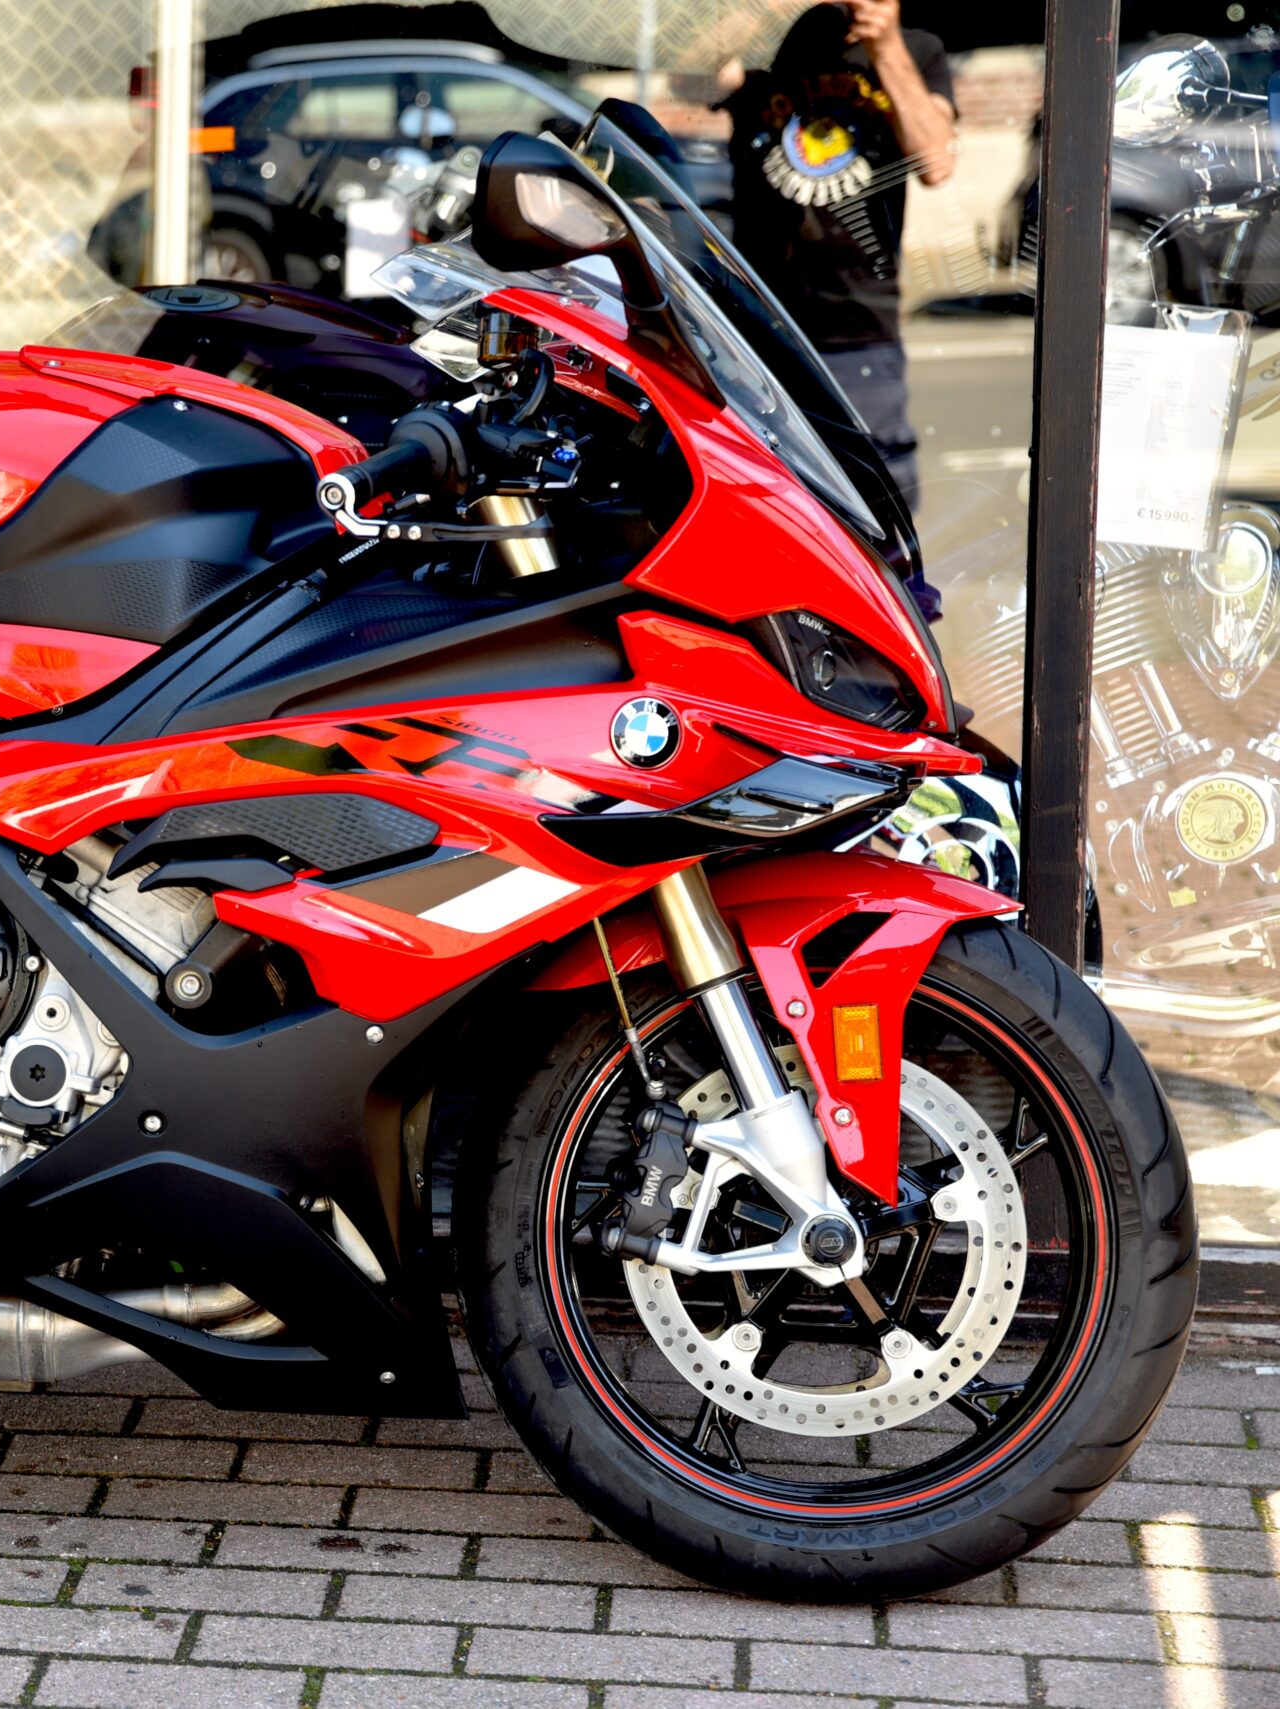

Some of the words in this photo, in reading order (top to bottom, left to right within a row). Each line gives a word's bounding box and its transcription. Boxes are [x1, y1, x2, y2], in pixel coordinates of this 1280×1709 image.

[798, 614, 823, 632] BMW
[622, 700, 678, 728] BMW
[1182, 792, 1200, 843] INDIAN
[1204, 783, 1261, 844] MOTORCYCLE
[640, 1164, 663, 1207] BMW
